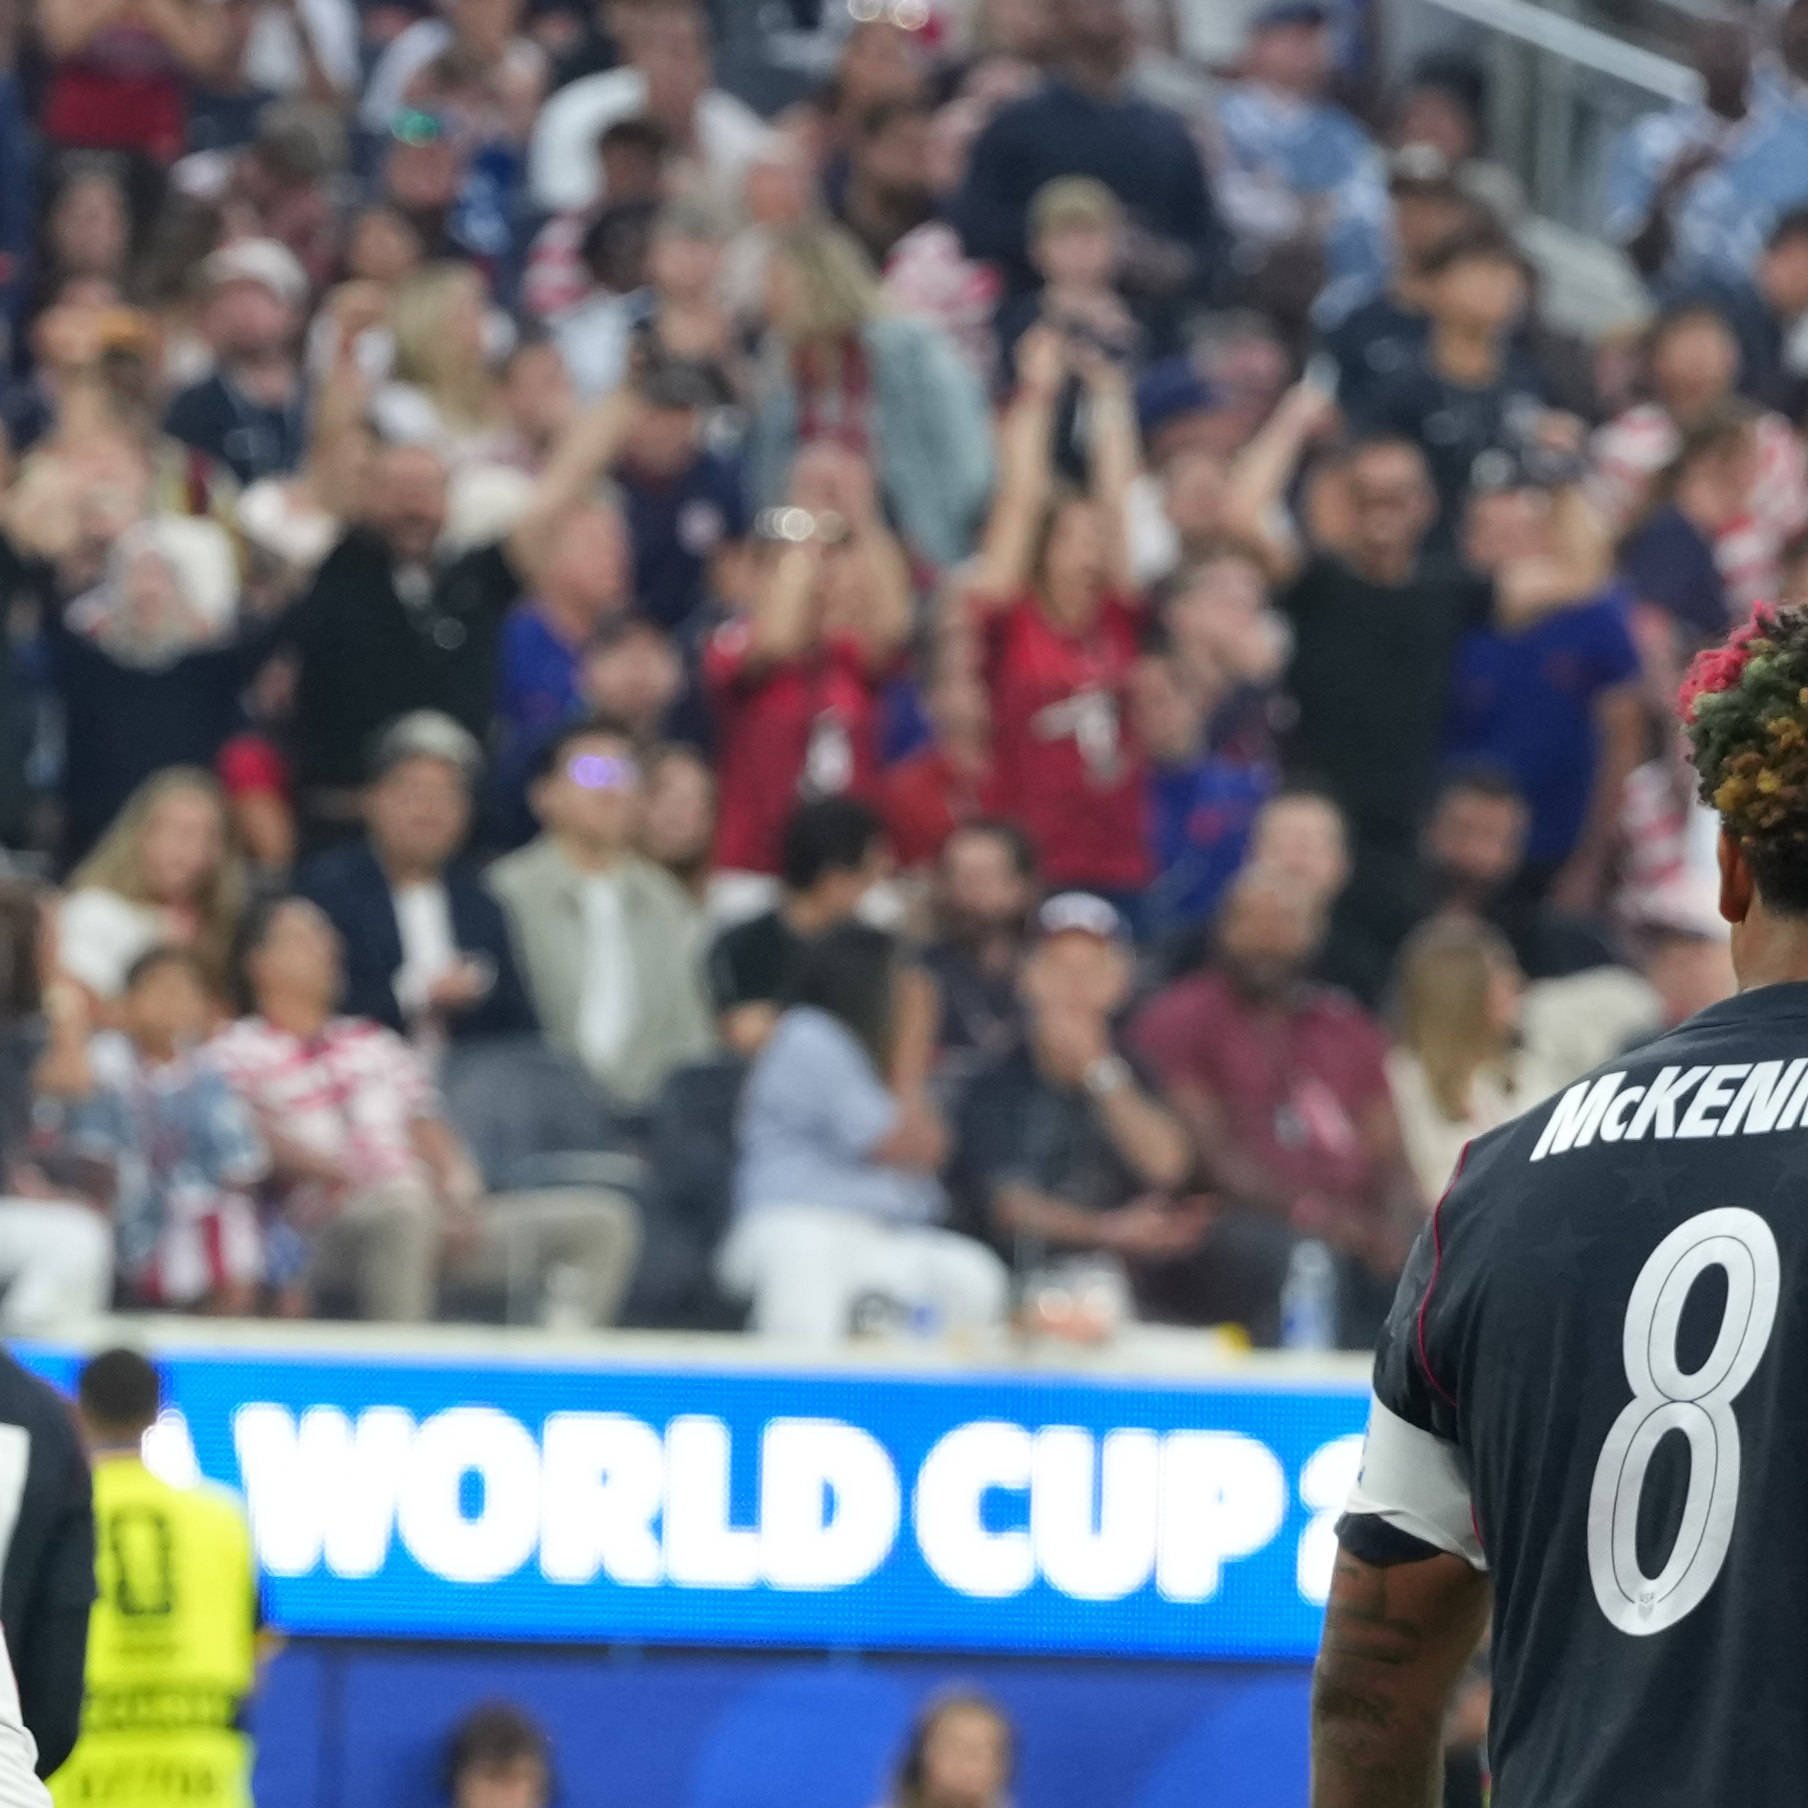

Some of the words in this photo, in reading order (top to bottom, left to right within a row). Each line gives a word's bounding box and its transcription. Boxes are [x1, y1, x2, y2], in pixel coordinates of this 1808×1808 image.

[236, 1401, 902, 1590] WORLD
[914, 1420, 1286, 1604] CUP
[1587, 1206, 1780, 1636] 8
